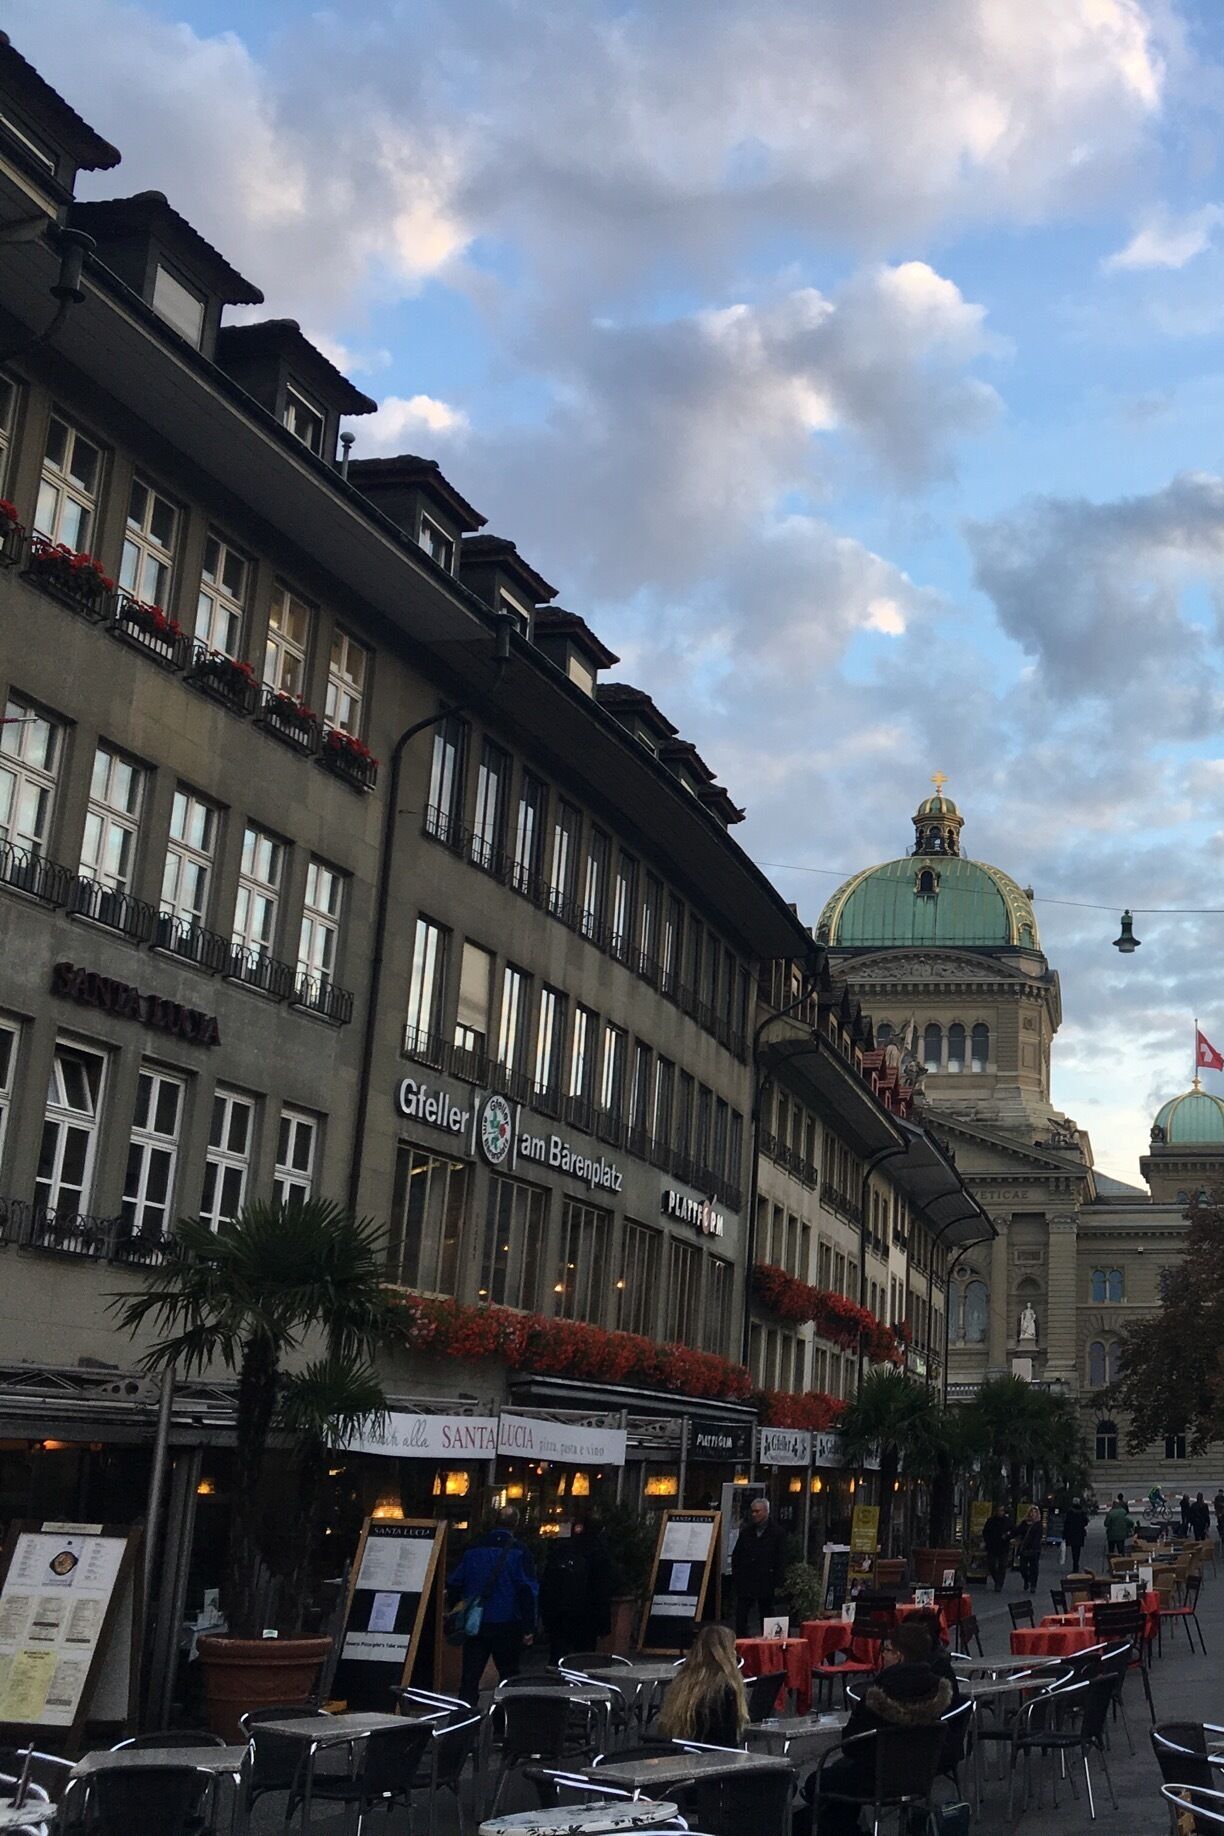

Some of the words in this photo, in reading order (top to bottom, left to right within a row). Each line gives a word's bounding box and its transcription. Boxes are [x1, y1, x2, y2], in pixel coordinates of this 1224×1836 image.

[52, 963, 139, 1019] SANTA
[143, 995, 219, 1047] LUCIA
[399, 1078, 469, 1133] Gfeller
[521, 1133, 545, 1161] am
[549, 1135, 623, 1193] Bärenplatz
[402, 1418, 429, 1448] alla
[442, 1425, 496, 1450] SANTA
[500, 1423, 533, 1449] LUCIA
[587, 1443, 604, 1457] vino
[374, 1527, 401, 1536] SANTA
[403, 1528, 430, 1537] LUCIA
